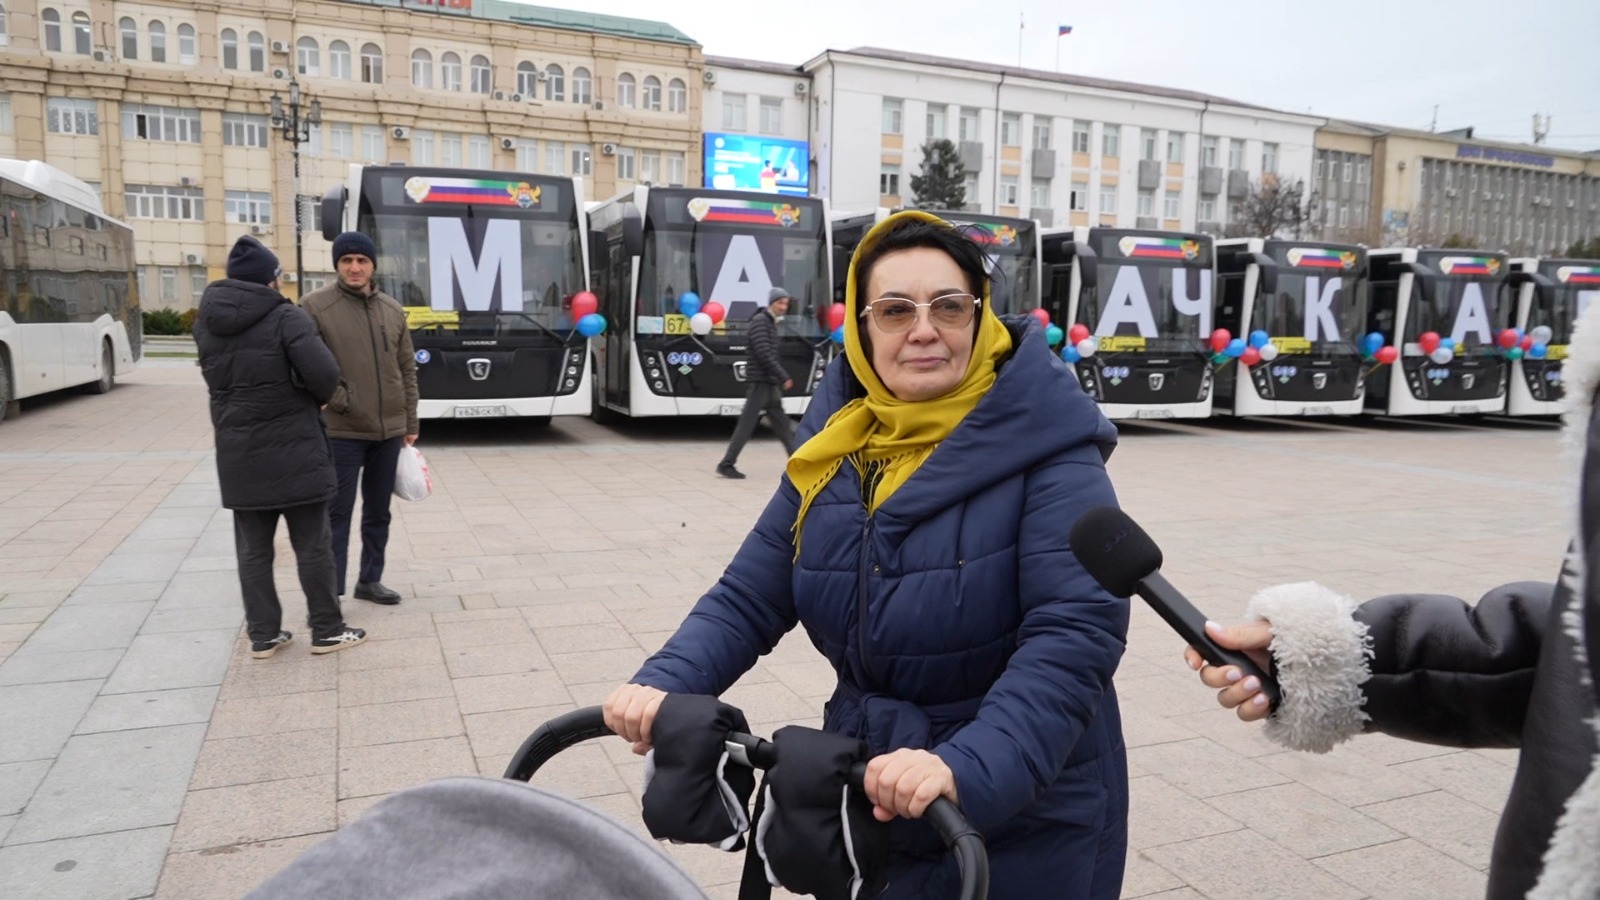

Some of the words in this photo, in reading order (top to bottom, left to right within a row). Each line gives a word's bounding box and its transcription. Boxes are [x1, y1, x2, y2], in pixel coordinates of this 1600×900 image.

[427, 216, 523, 311] М
[708, 234, 776, 319] А
[667, 317, 685, 332] 67
[1304, 276, 1342, 342] К
[1450, 282, 1493, 344] А
[1101, 337, 1115, 350] 67
